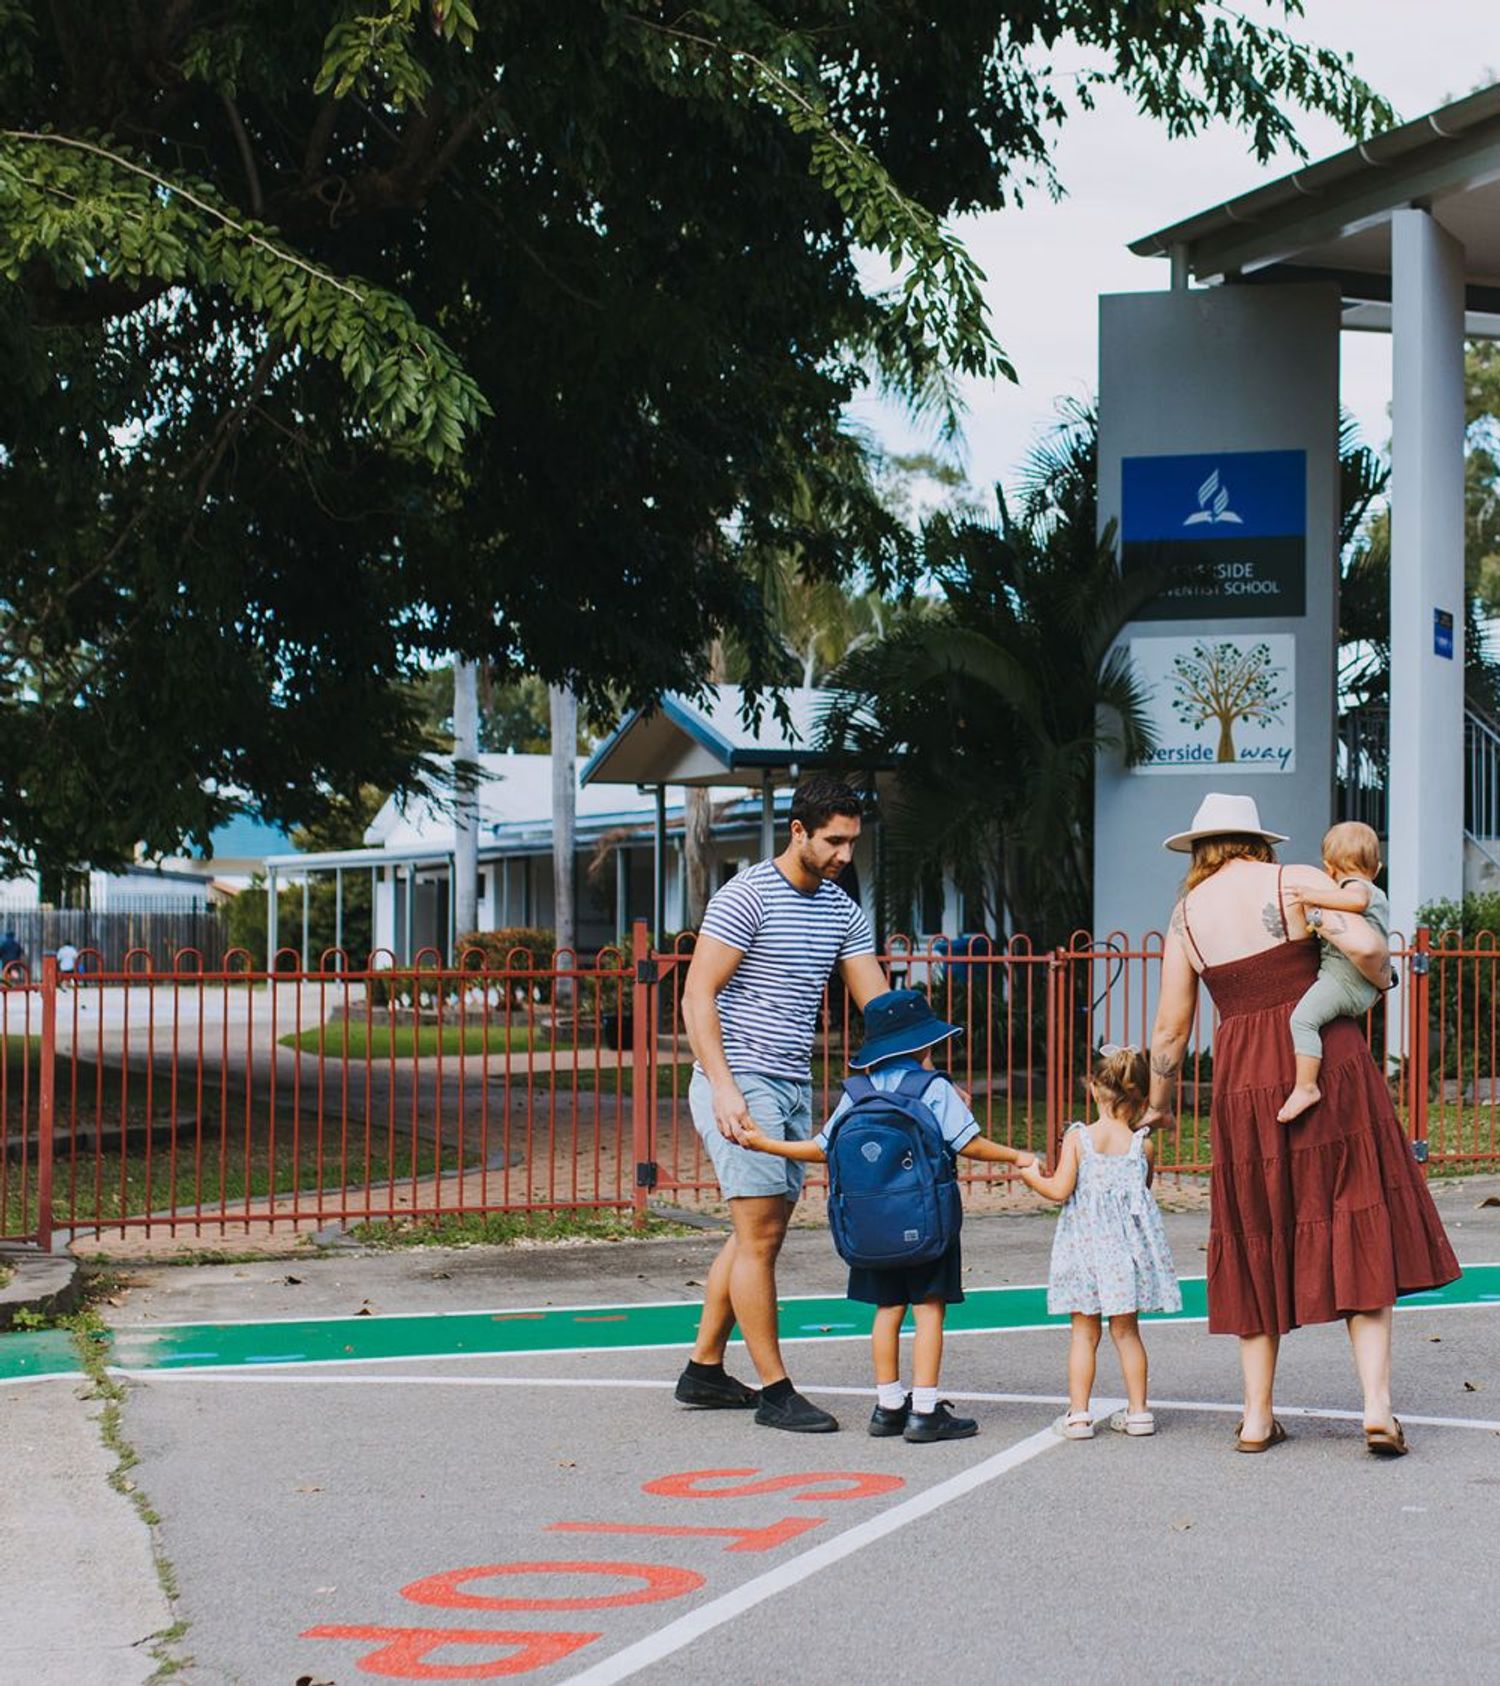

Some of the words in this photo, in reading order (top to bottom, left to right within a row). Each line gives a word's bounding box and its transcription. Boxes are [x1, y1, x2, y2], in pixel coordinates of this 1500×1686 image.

[1223, 580, 1281, 596] SCHOOL
[1240, 746, 1293, 771] way
[298, 1466, 908, 1681] STOP
